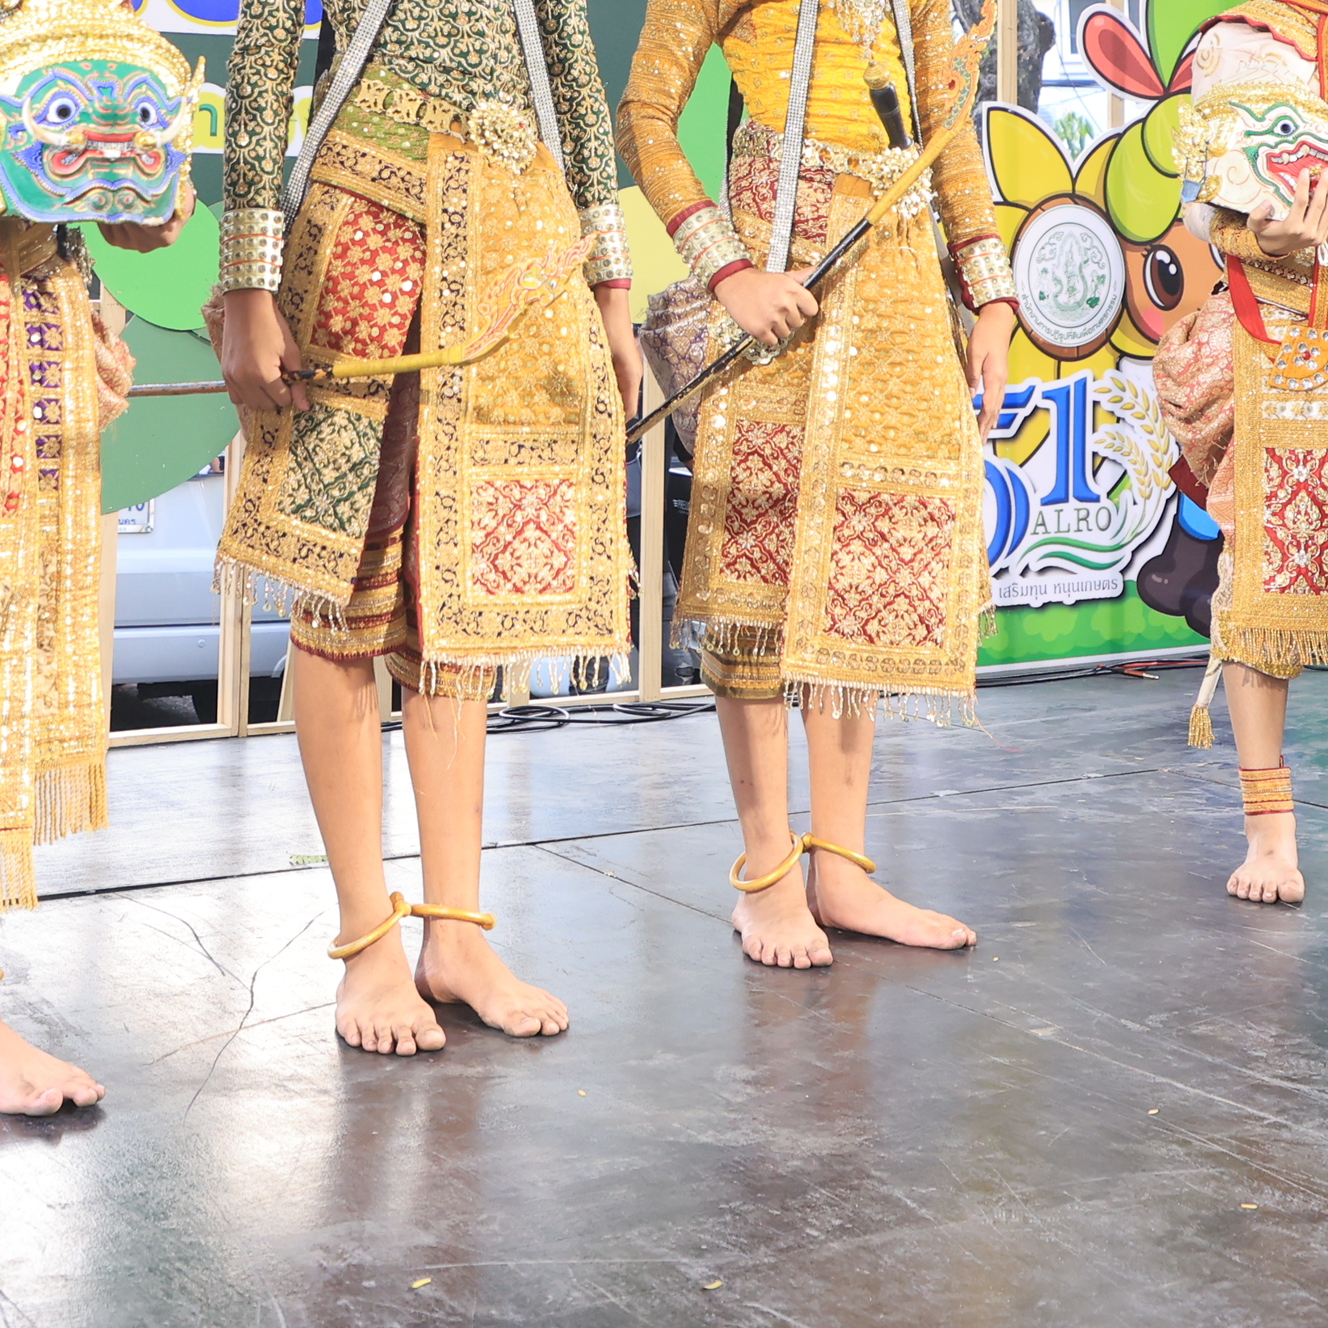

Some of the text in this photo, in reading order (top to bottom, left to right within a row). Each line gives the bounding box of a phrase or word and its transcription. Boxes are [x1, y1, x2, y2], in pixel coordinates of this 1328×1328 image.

[1030, 506, 1112, 536] ALRO
[998, 578, 1118, 600] เสริมทุน หนุนเกษตร
